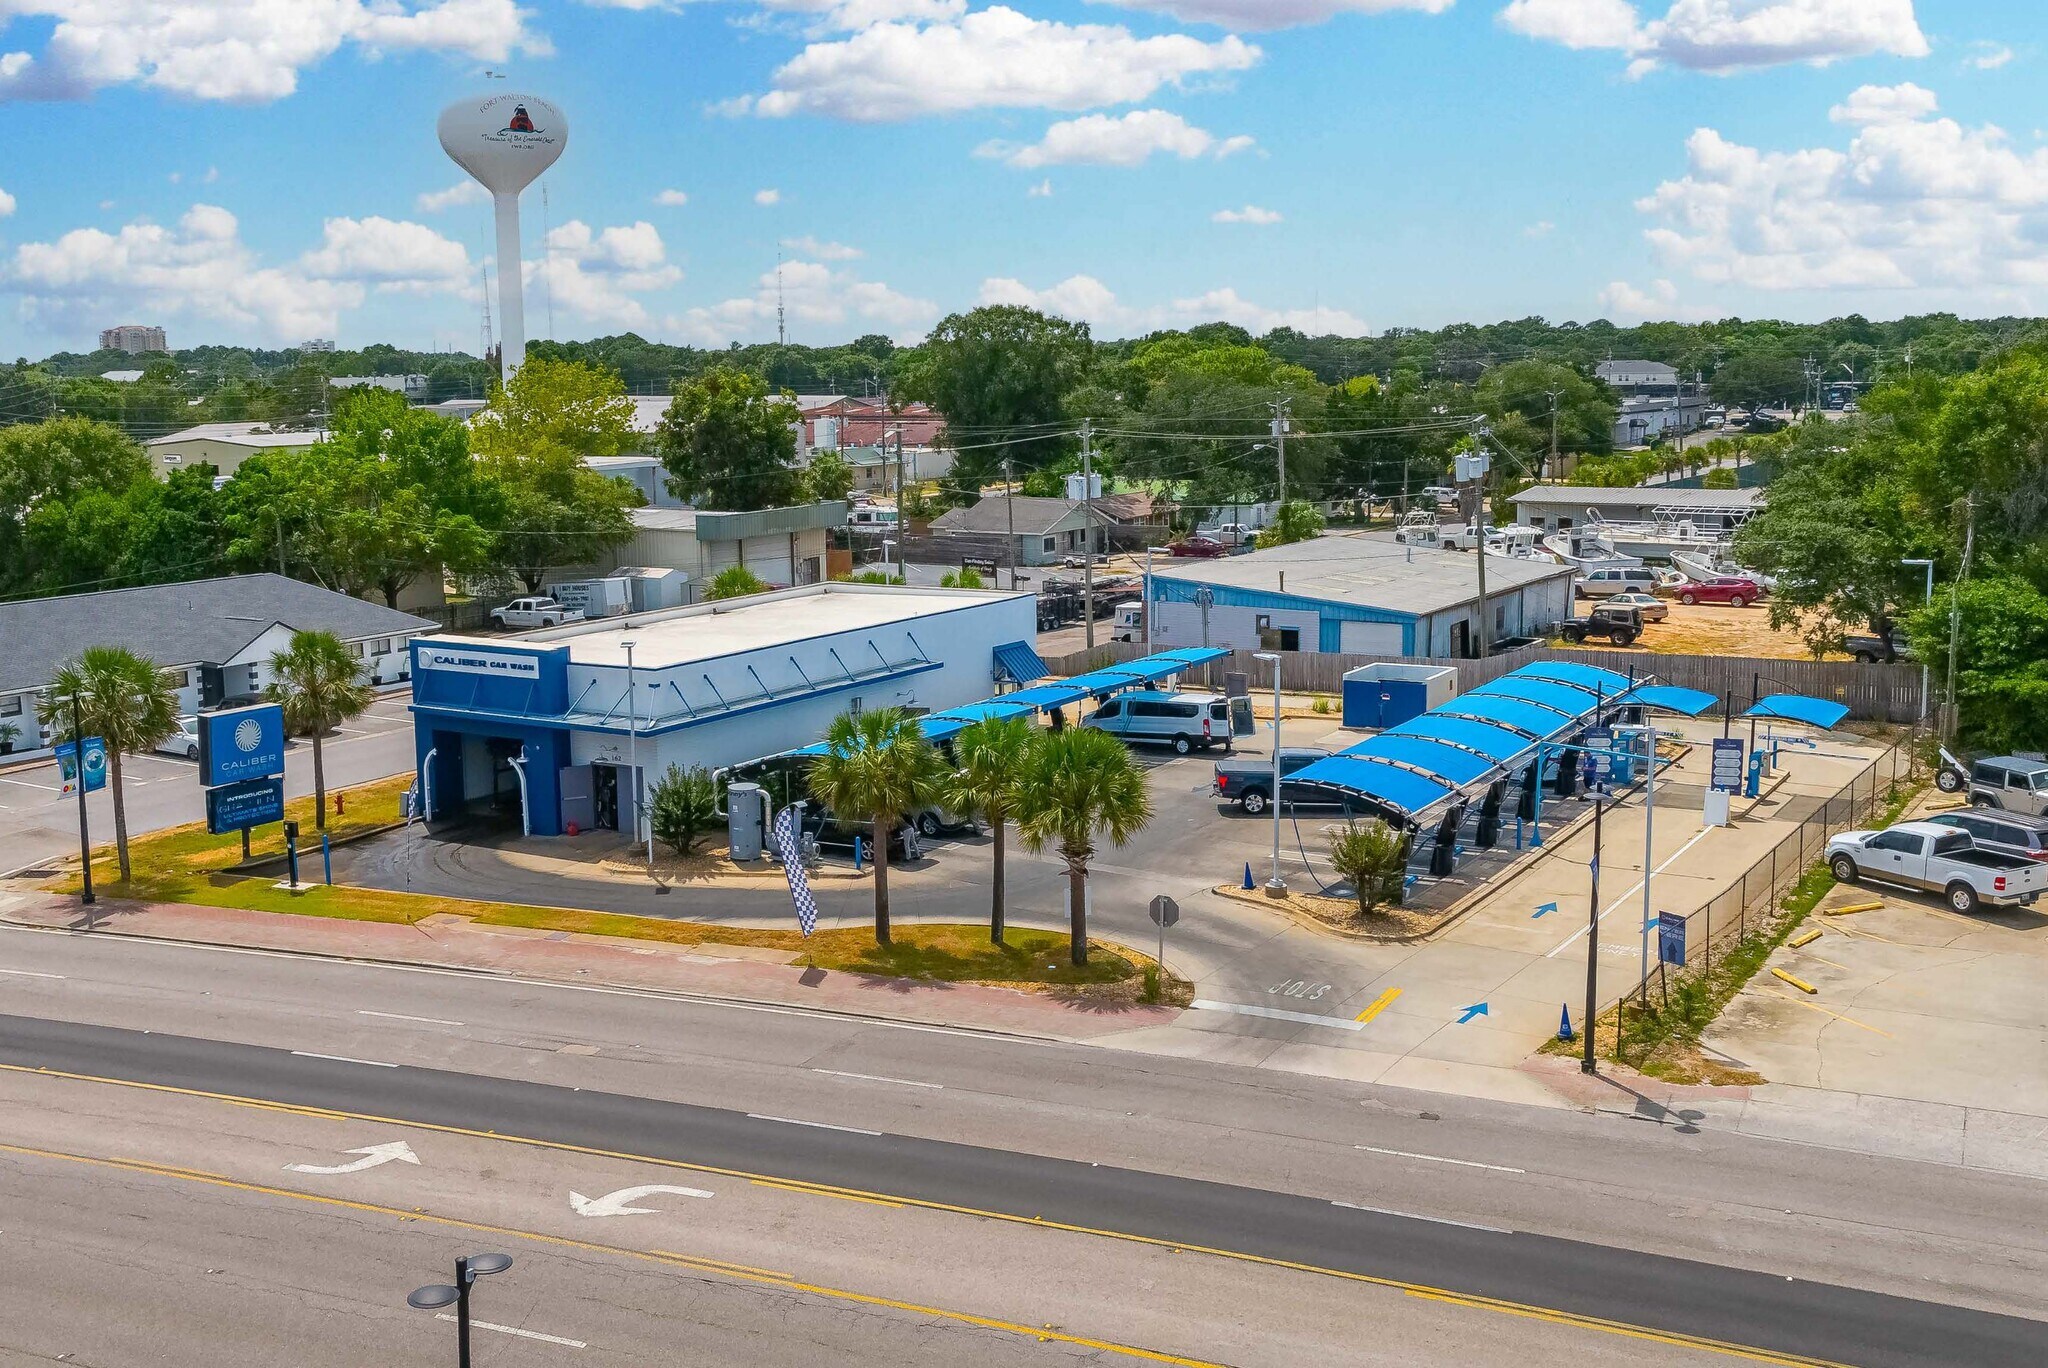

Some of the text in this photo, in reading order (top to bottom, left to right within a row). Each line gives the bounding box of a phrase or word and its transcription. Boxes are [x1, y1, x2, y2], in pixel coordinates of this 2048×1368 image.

[480, 98, 497, 113] FORT
[434, 656, 535, 672] CALIBER CAR WASH
[221, 754, 276, 770] CALIBER
[226, 764, 274, 777] CAR WASH
[227, 789, 273, 802] INTRODUCING
[1268, 979, 1332, 1000] STOP
